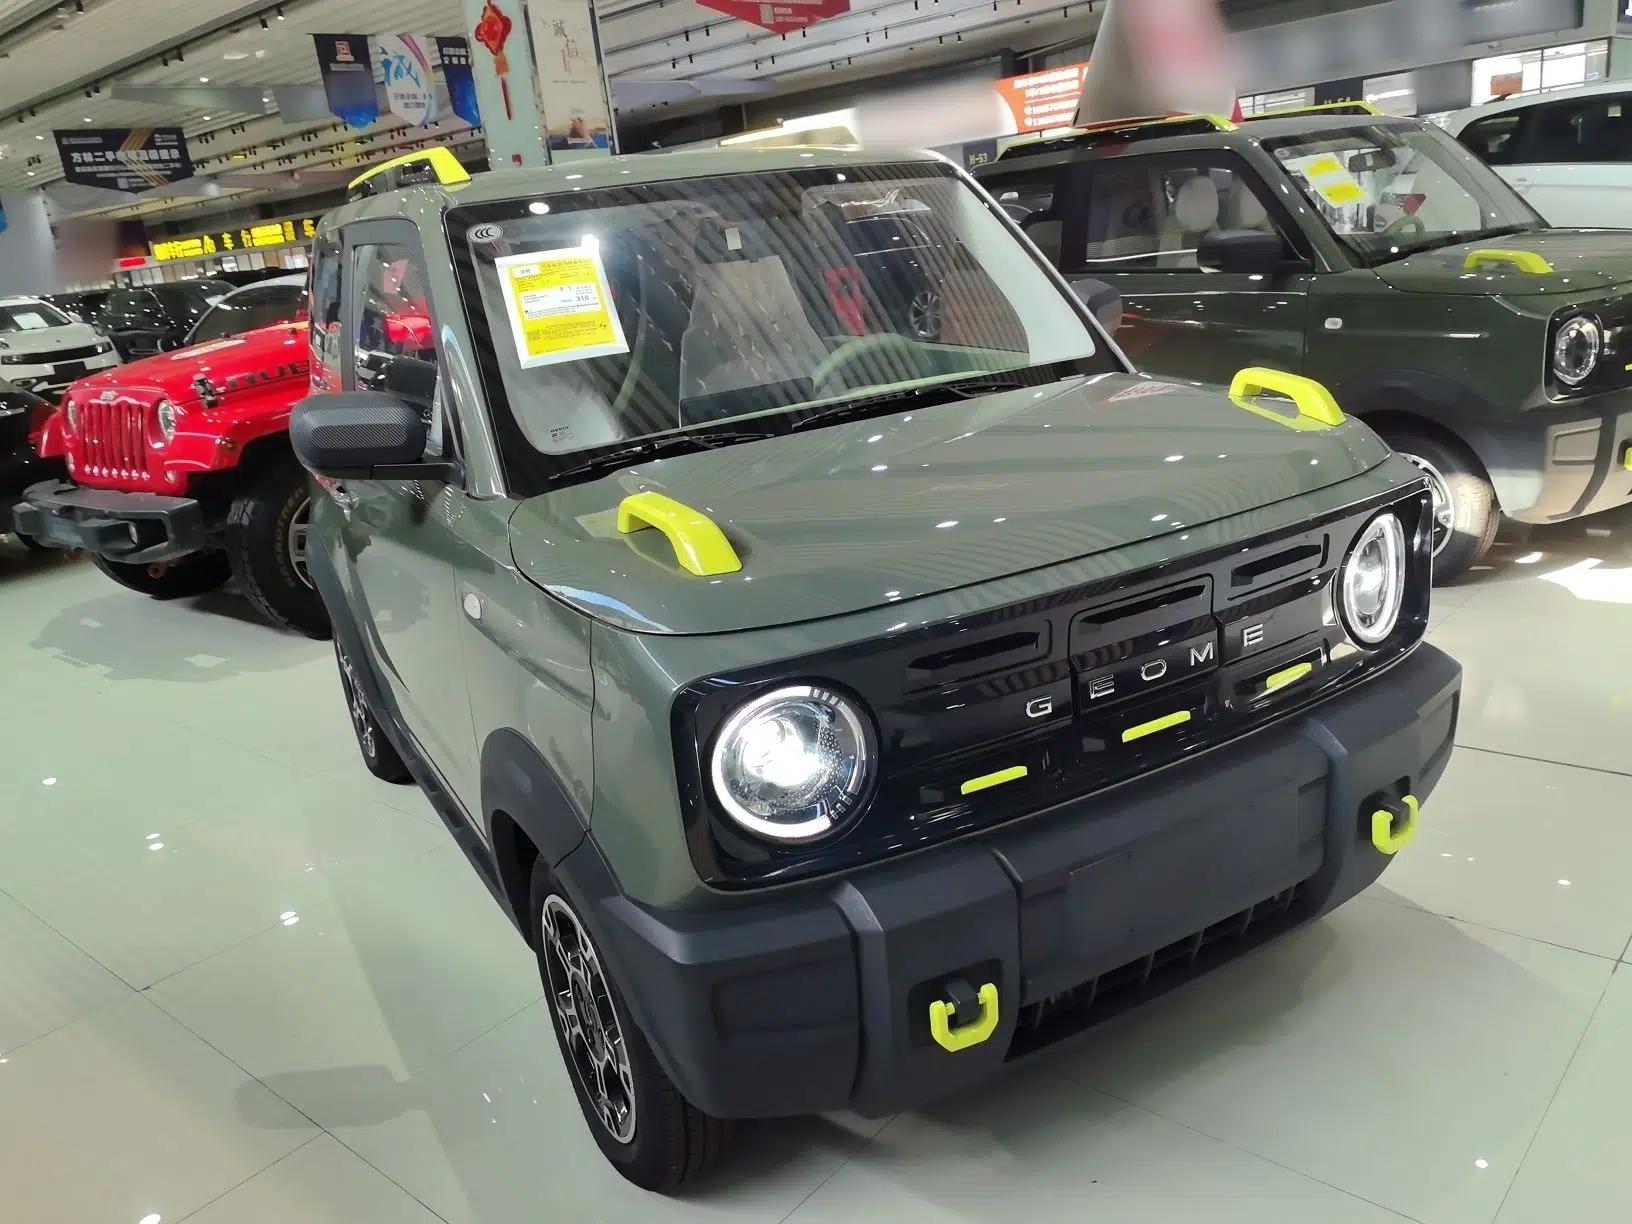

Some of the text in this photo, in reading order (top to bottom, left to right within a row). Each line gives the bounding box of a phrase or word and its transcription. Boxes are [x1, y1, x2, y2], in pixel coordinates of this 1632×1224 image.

[969, 152, 988, 165] H-53
[475, 227, 494, 239] CCC
[1025, 623, 1264, 718] GEOME
